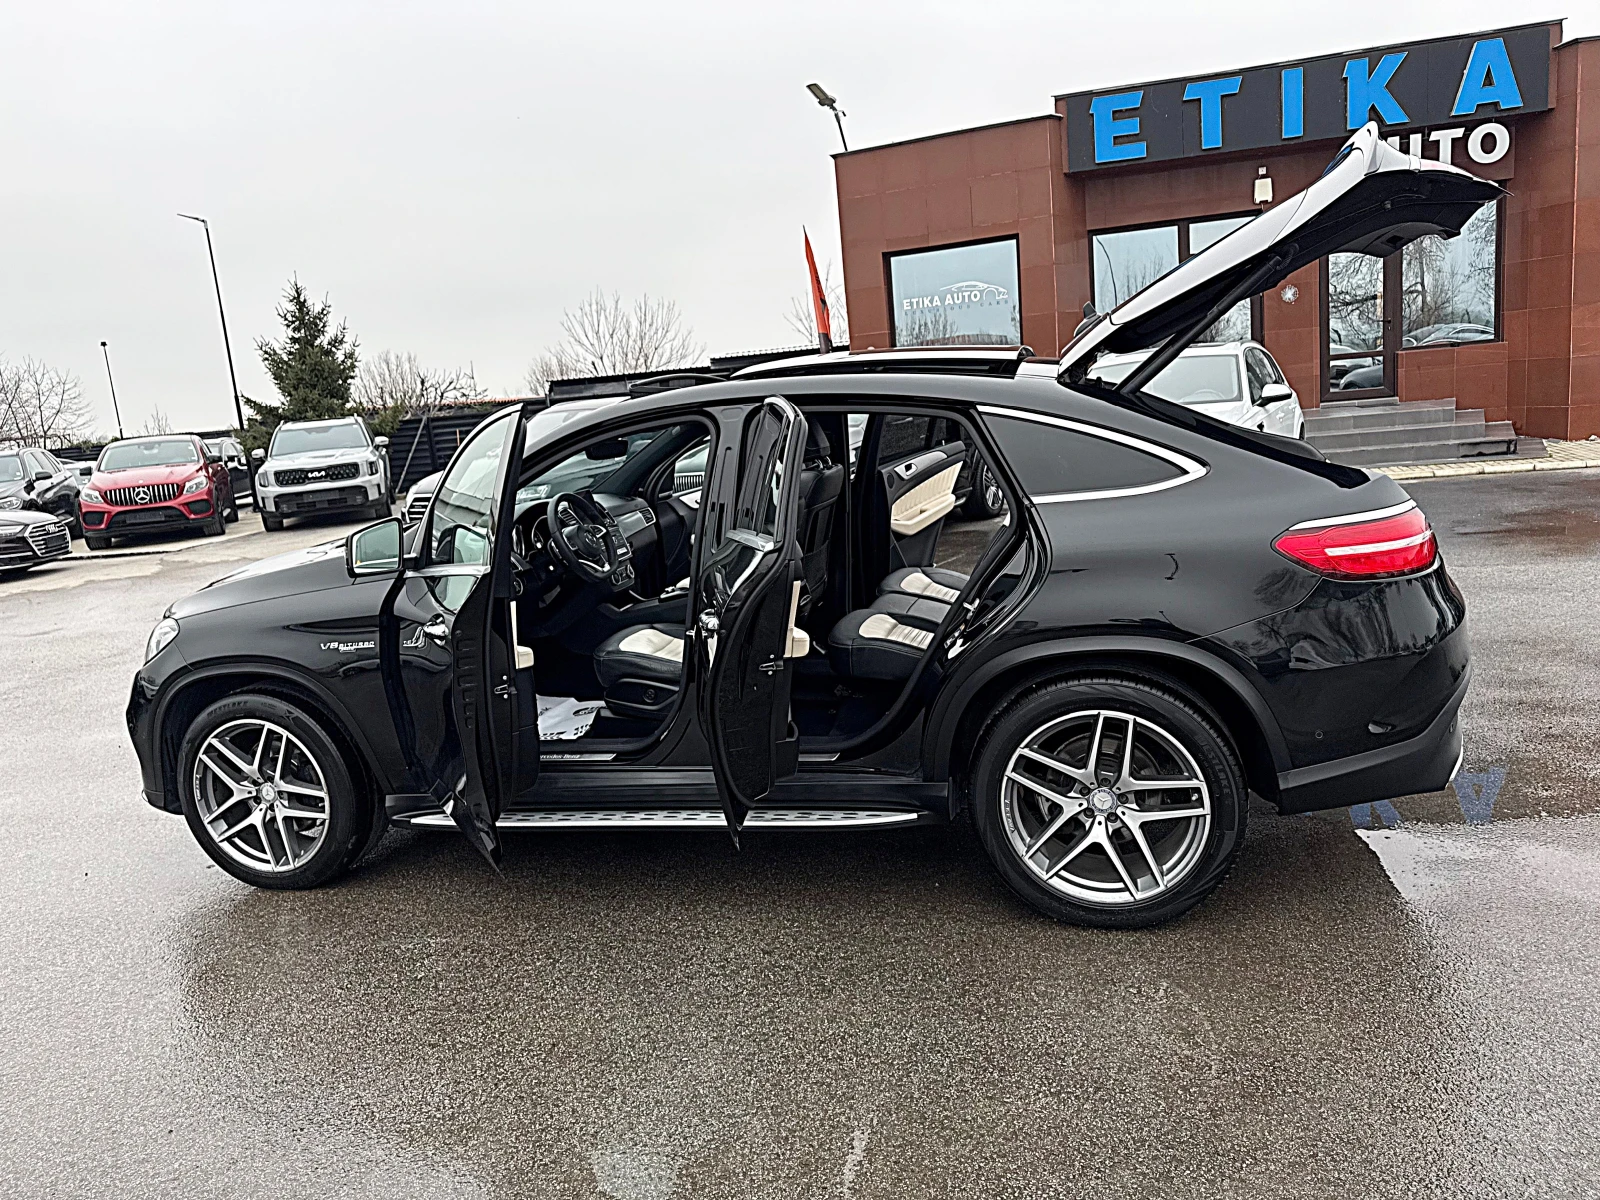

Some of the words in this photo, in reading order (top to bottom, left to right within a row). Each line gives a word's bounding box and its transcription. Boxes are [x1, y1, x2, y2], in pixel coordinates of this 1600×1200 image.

[1089, 37, 1524, 164] ETIKA
[902, 295, 941, 311] ETIKA
[944, 290, 981, 306] AUTO
